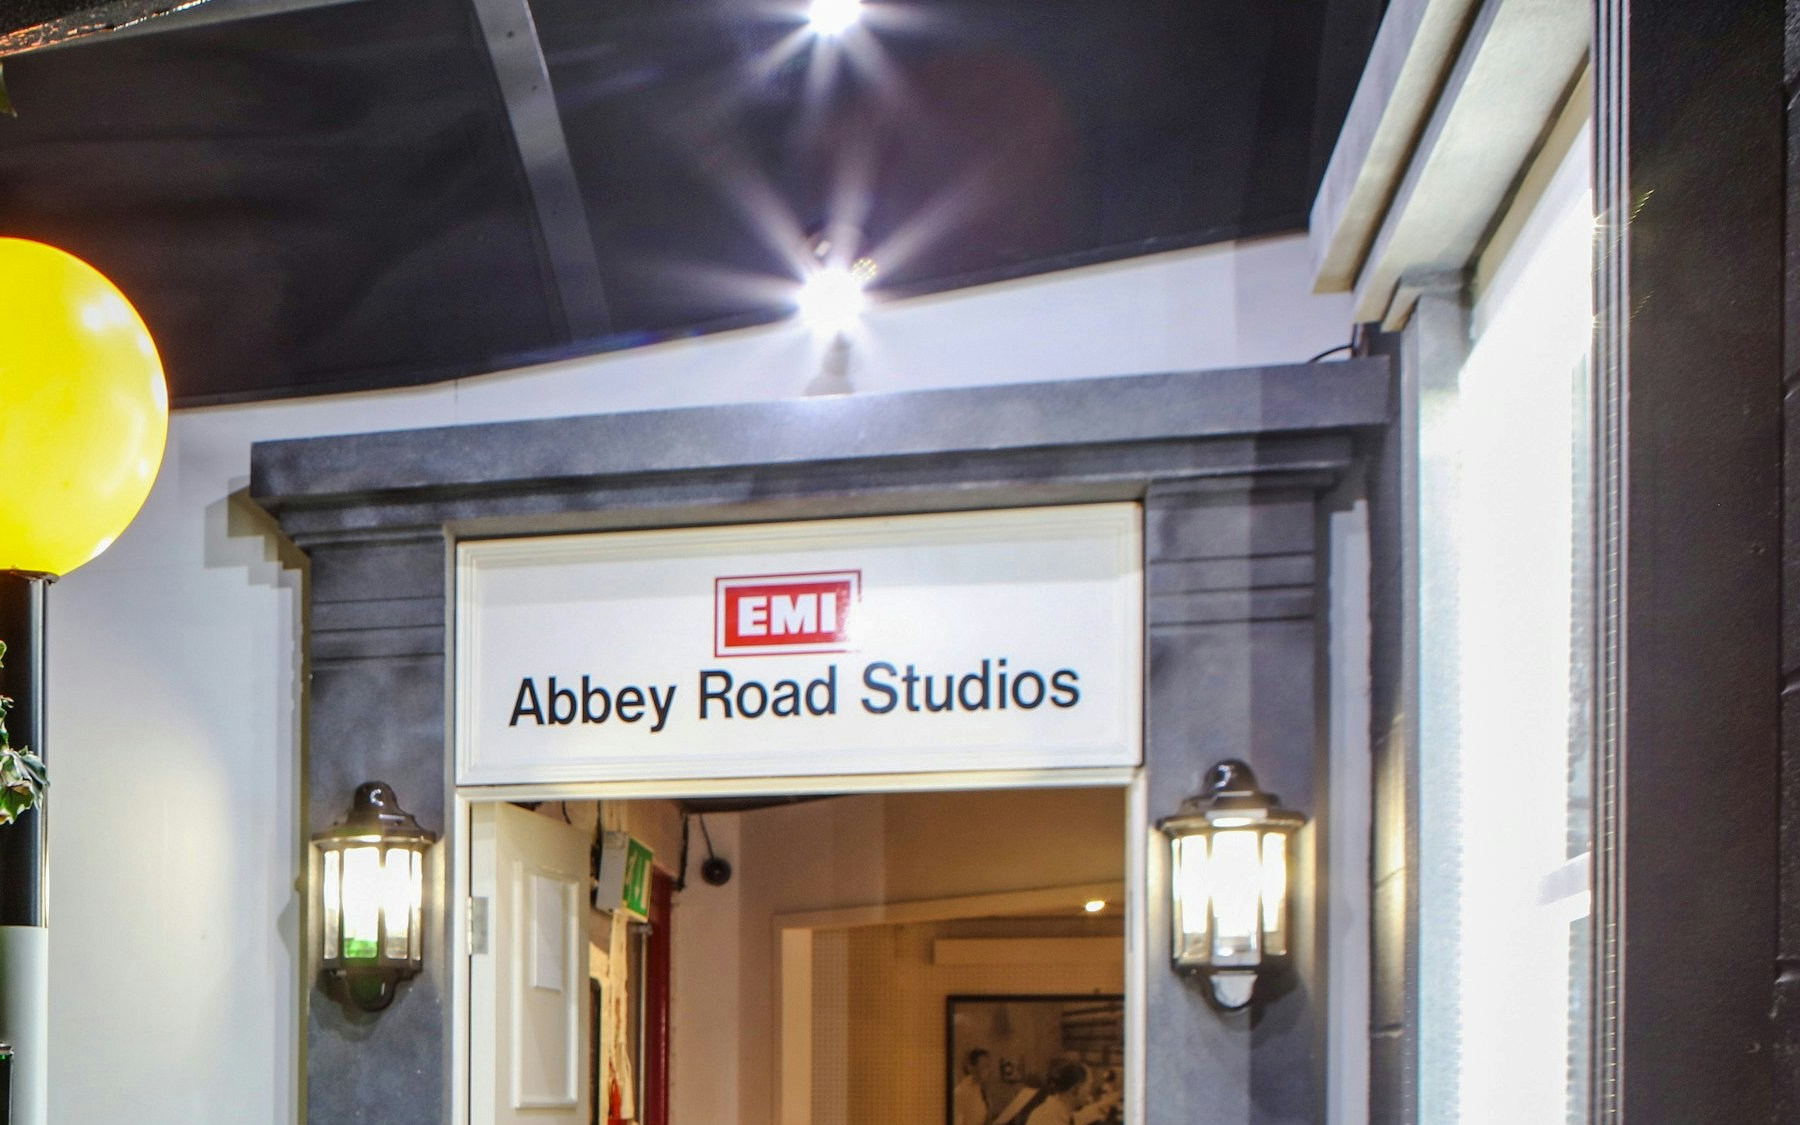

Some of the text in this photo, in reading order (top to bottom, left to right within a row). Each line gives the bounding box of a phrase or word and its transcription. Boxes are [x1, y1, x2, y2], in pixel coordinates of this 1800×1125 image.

[738, 591, 838, 637] EMI
[509, 658, 1082, 733] Abbey Road Studios
